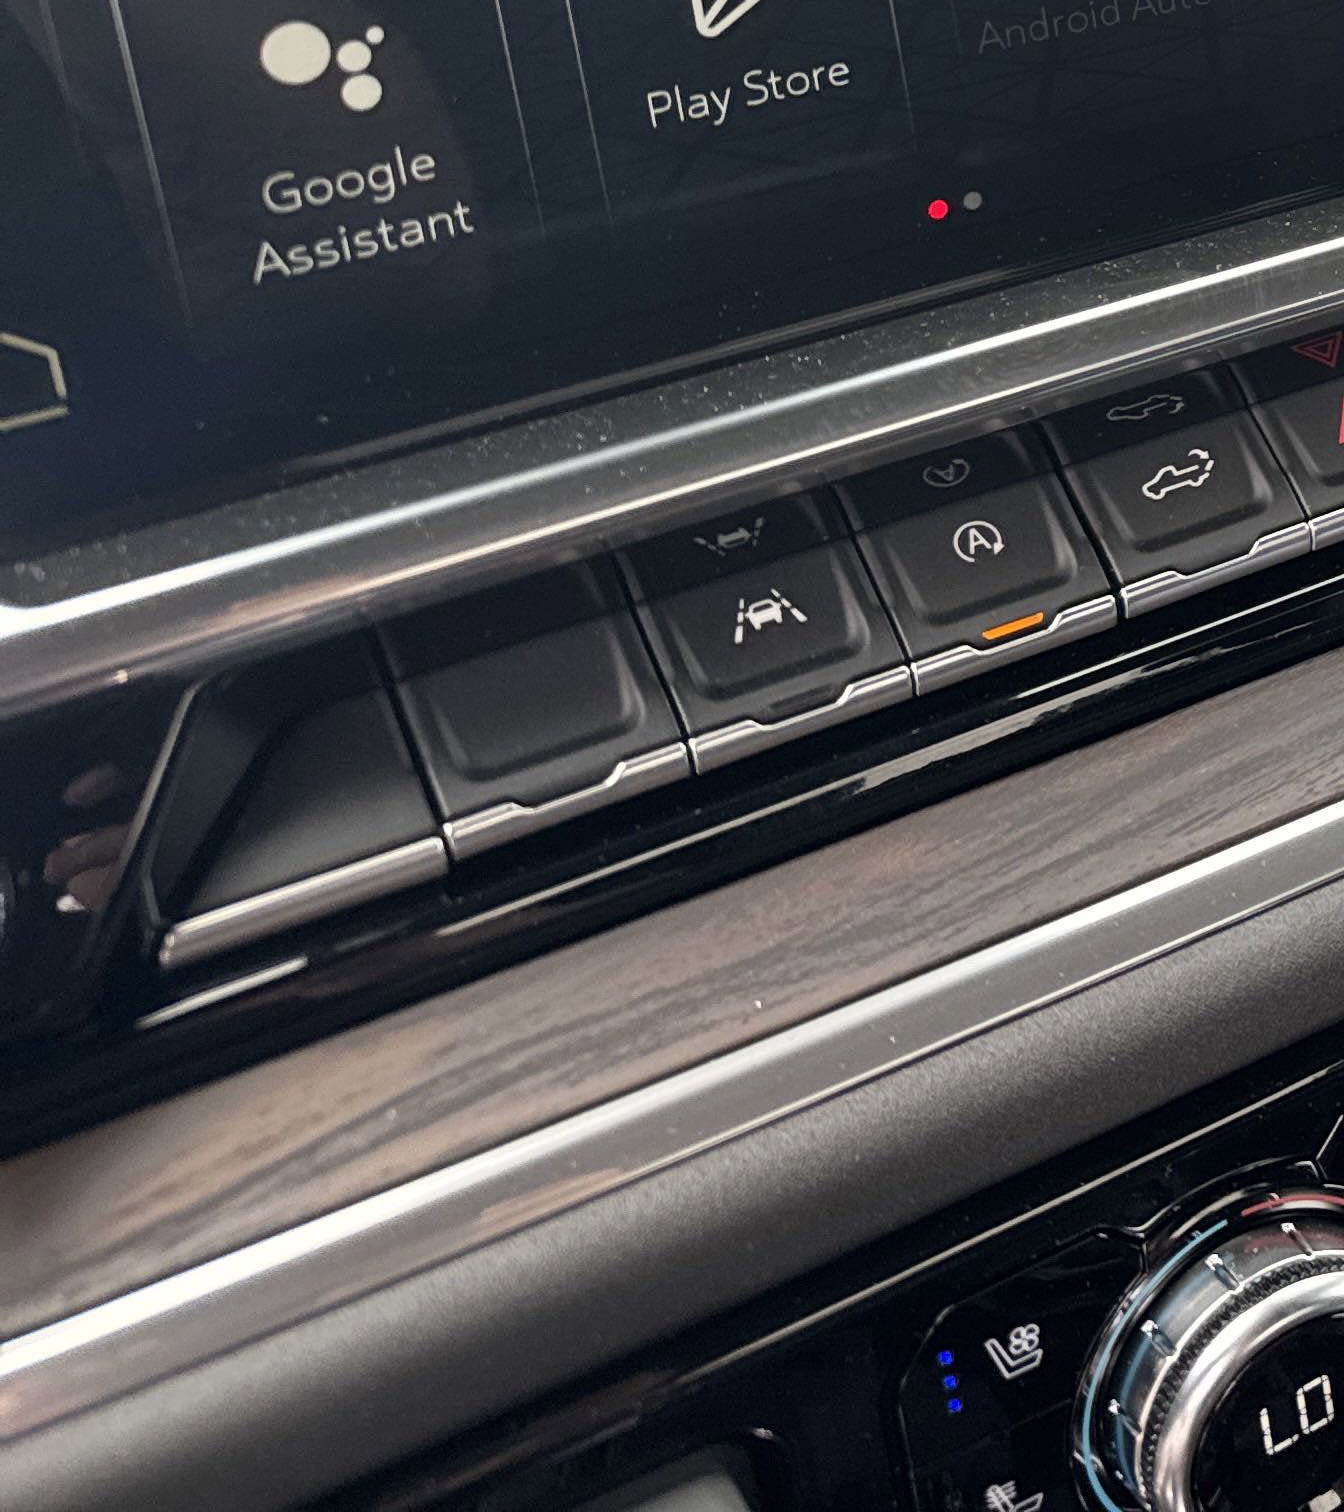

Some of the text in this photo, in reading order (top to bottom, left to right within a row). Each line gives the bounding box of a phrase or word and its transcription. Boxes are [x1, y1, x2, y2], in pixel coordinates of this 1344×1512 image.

[977, 0, 1121, 55] Android
[646, 59, 853, 129] Play Store
[261, 146, 438, 216] Google
[252, 200, 476, 285] Assistant
